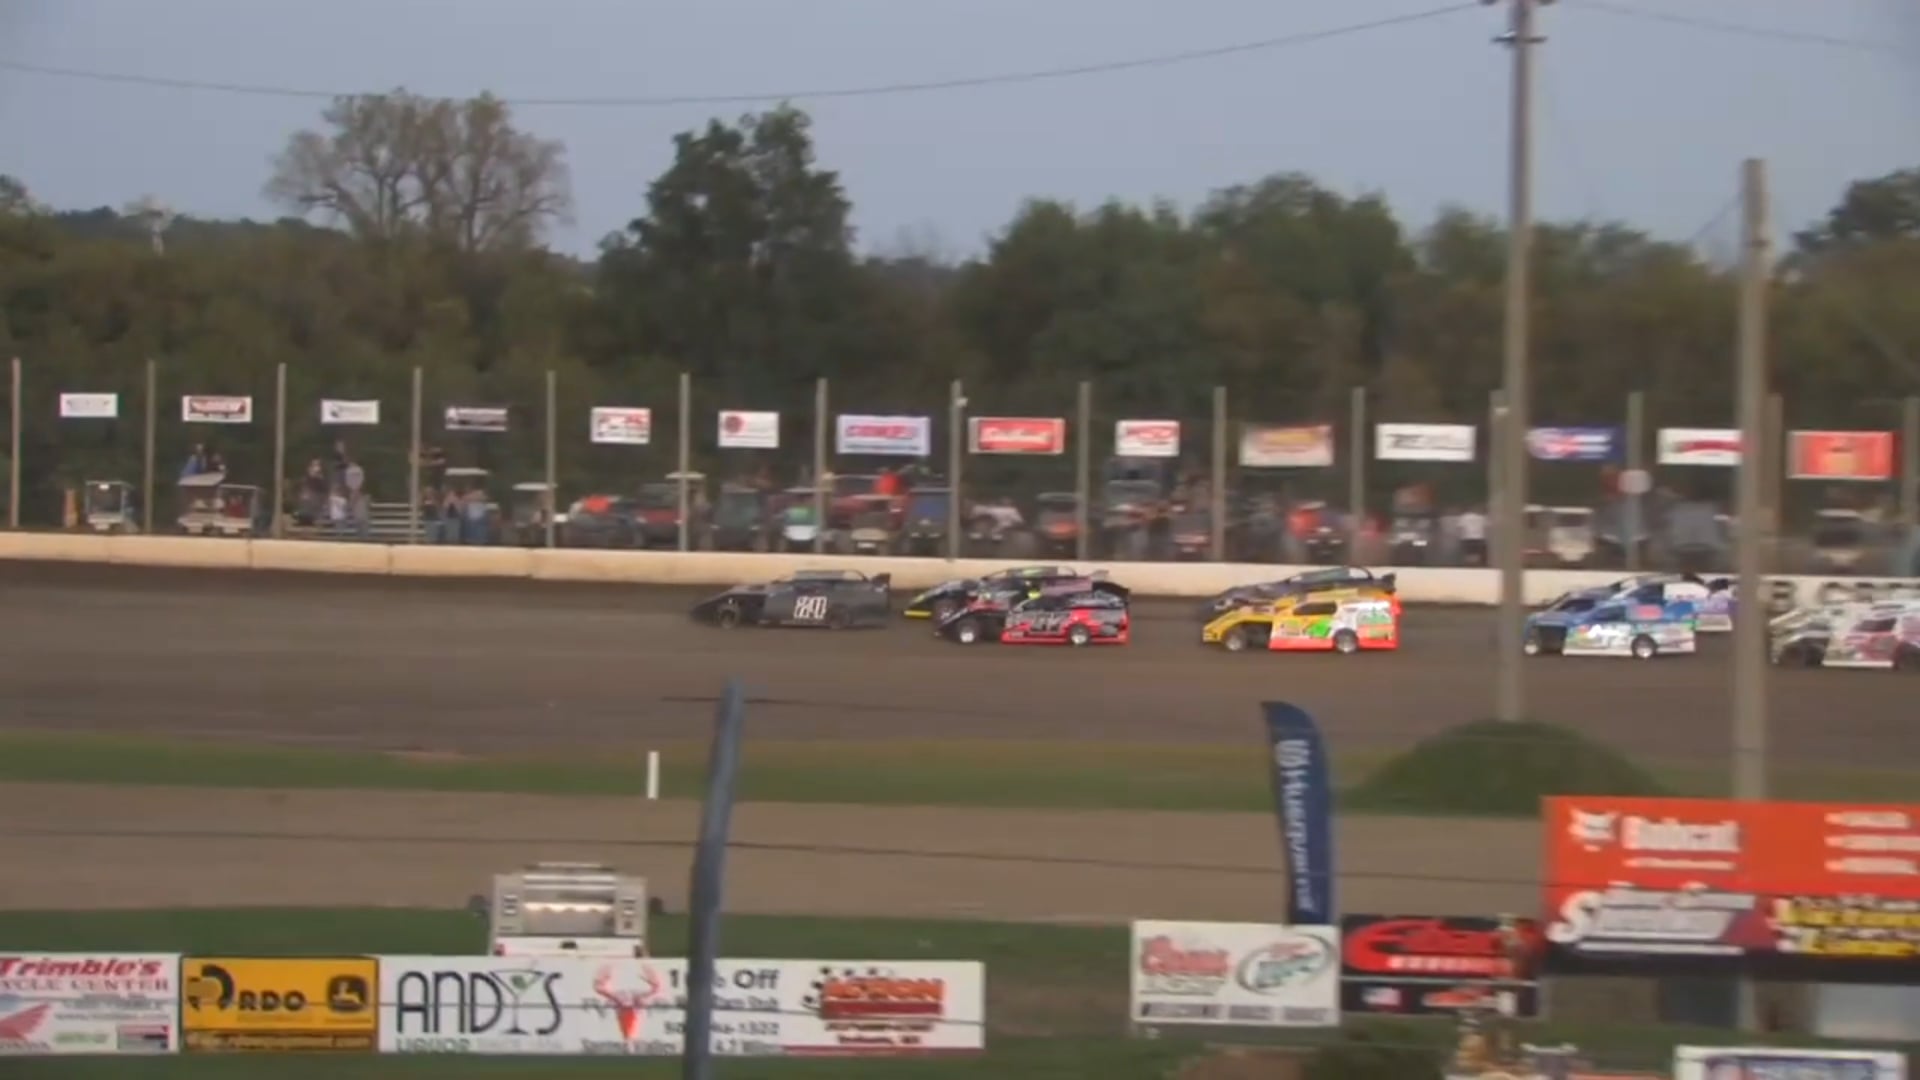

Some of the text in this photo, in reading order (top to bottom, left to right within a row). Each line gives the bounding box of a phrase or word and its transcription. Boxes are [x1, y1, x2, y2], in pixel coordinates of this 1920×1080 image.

[0, 979, 60, 991] YCLE
[733, 969, 780, 990] Off
[238, 990, 307, 1013] RDO
